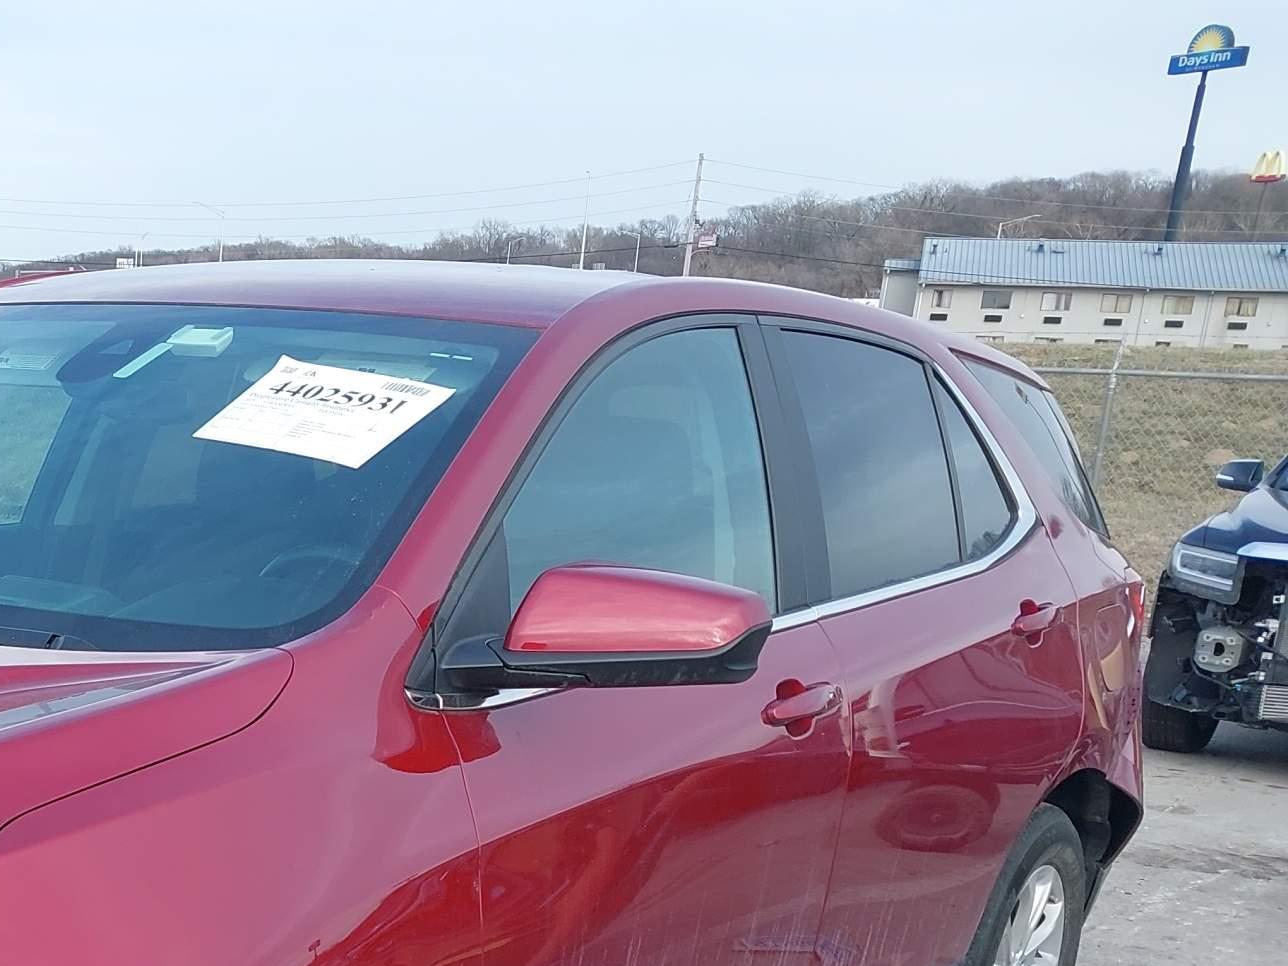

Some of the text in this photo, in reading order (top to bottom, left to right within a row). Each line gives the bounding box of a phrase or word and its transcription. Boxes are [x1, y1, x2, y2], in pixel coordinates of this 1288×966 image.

[1178, 53, 1209, 68] Days
[1210, 51, 1231, 63] Inn
[269, 380, 409, 414] 44025931
